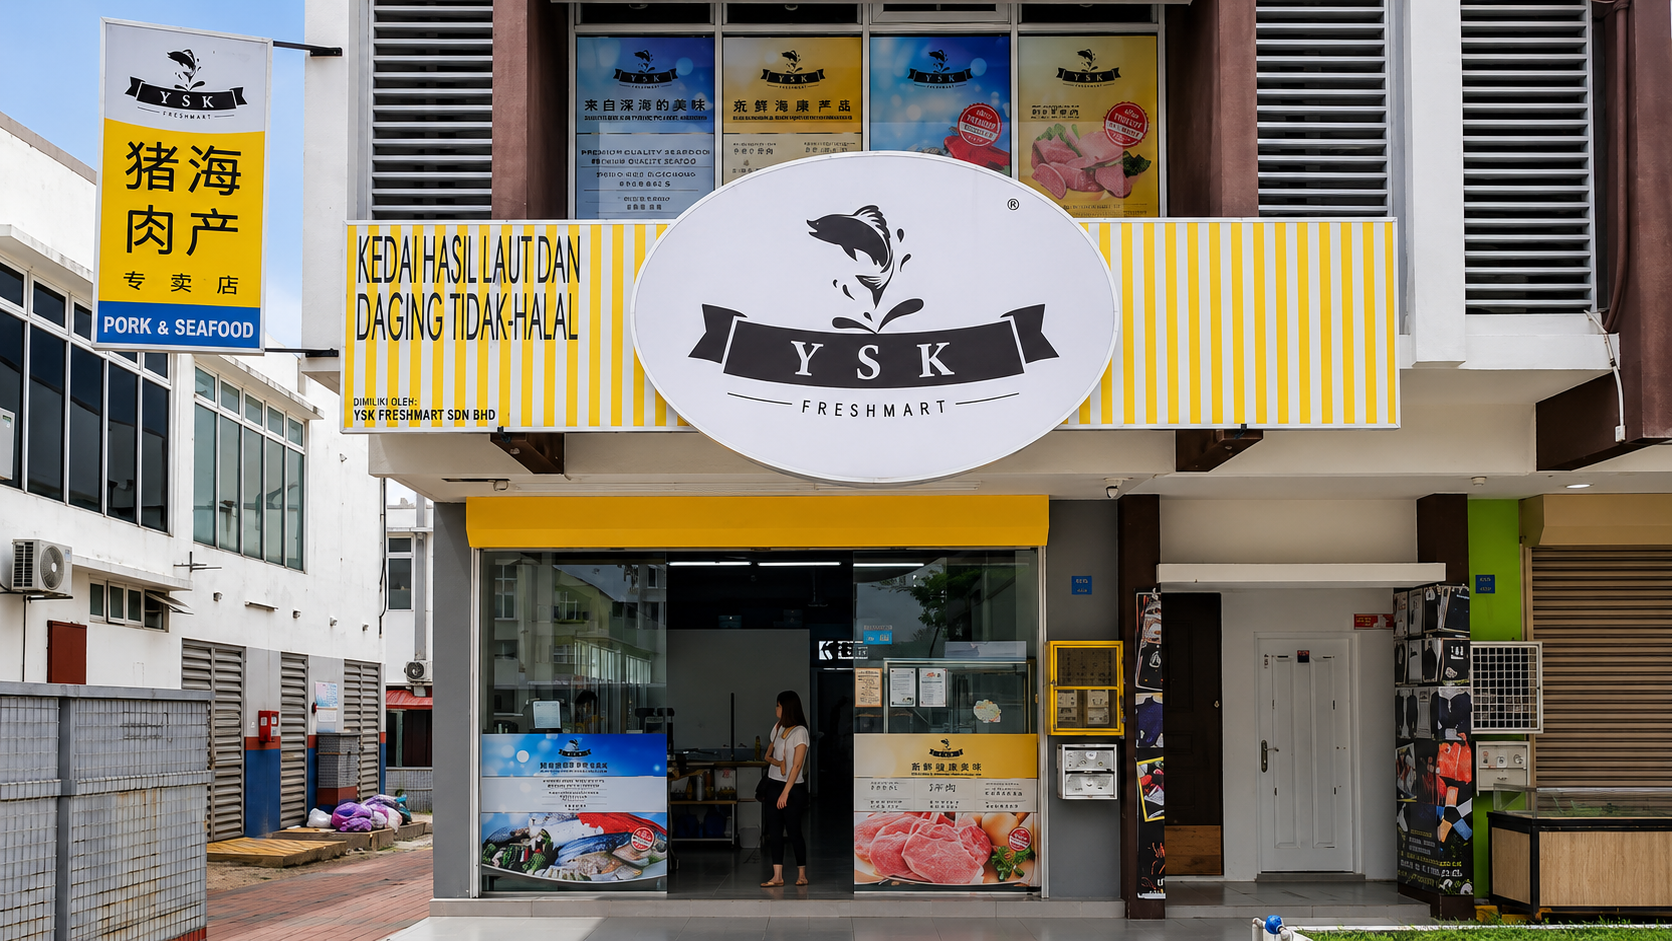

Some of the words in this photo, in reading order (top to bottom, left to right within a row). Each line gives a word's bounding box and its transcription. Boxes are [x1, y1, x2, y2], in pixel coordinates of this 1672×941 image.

[1073, 73, 1103, 82] YSK
[160, 90, 214, 109] YSK
[163, 110, 212, 120] FRESHMART
[358, 235, 418, 284] KEDAI
[423, 234, 477, 284] HASIL
[483, 235, 533, 284] LAUT
[537, 235, 581, 284] DAN
[124, 271, 239, 295] 专卖店
[356, 291, 443, 342] DAGING
[449, 292, 578, 341] TIDAK-HALAL
[103, 316, 152, 335] PORK
[158, 320, 169, 335] &
[175, 318, 254, 338] SEAFOOD
[791, 340, 956, 381] YSK
[353, 397, 389, 407] DIMILIKI
[391, 397, 418, 407] OLEH:
[802, 399, 946, 418] FRESHMART
[354, 409, 376, 421] YSK
[378, 409, 445, 421] FRESHMART
[447, 409, 470, 421] SDN
[473, 409, 496, 421] BHD
